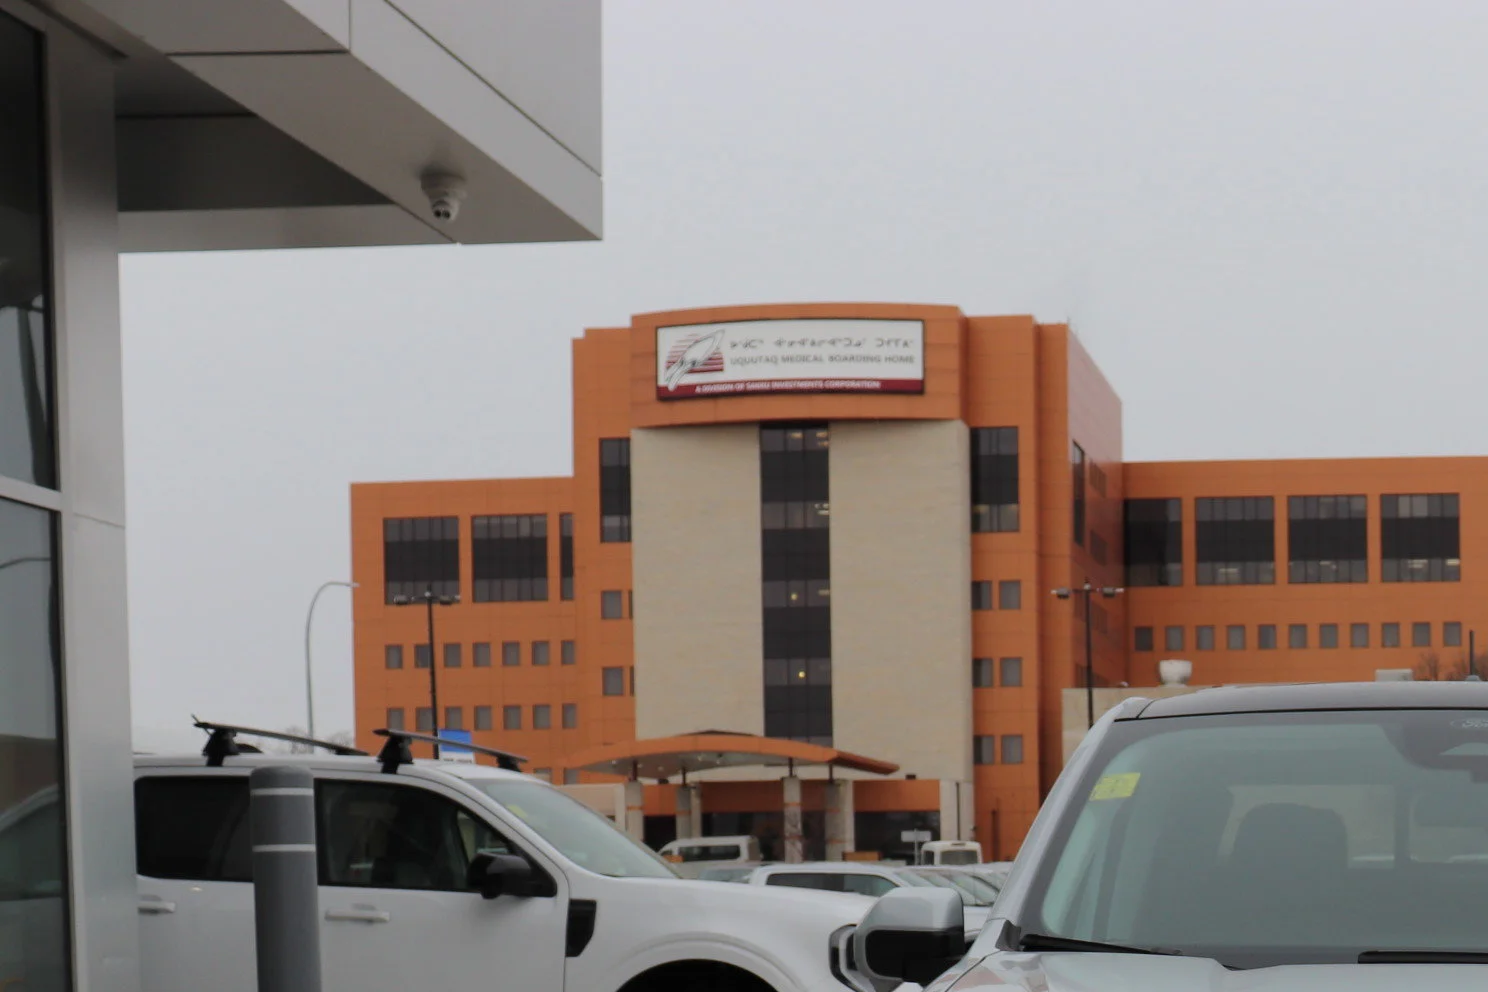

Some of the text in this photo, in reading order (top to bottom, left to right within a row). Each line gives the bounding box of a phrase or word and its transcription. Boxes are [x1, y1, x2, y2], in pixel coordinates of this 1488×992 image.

[781, 354, 823, 364] MEDICAL
[828, 354, 882, 364] BOARDING
[884, 354, 916, 365] HOME
